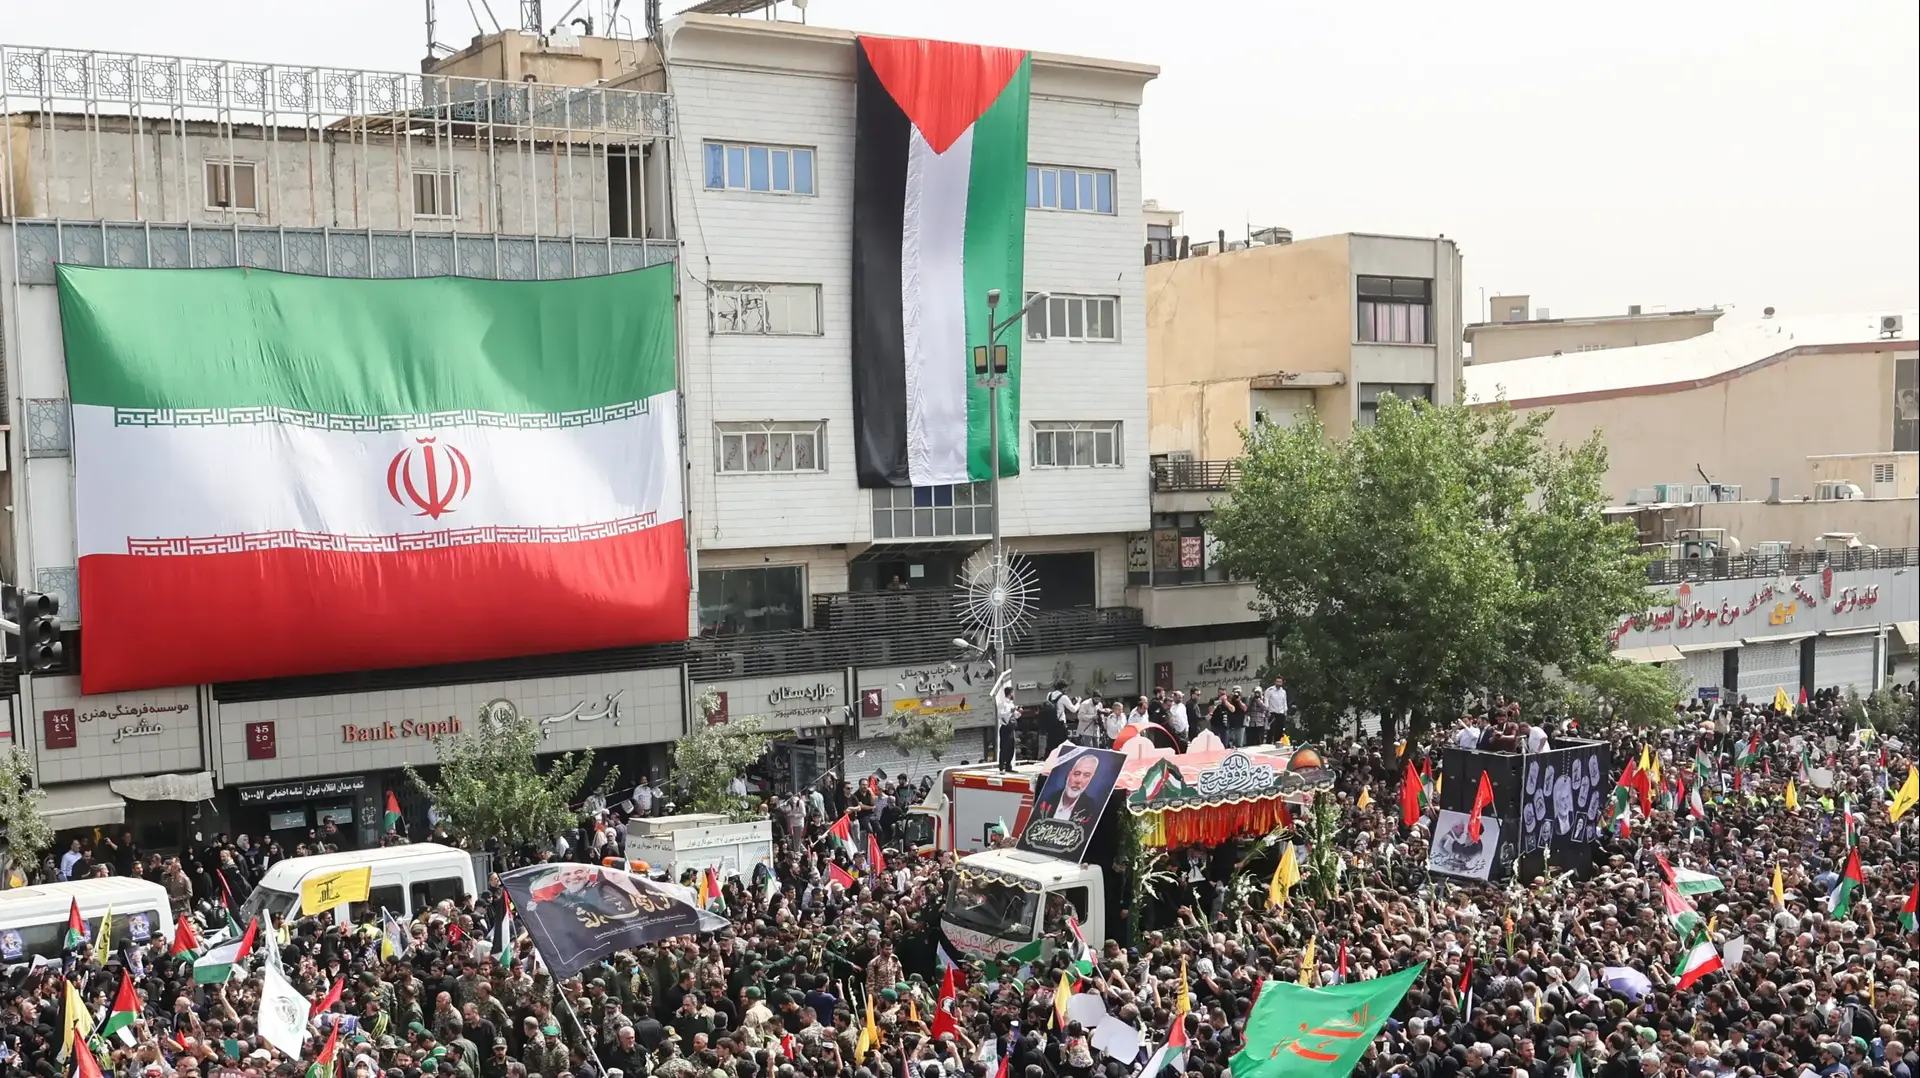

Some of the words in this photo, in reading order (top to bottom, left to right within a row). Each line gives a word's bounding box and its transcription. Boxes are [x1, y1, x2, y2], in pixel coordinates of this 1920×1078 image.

[78, 708, 108, 723] هنری
[108, 703, 148, 719] فرهنگی
[149, 703, 190, 714] موسسه
[52, 714, 68, 723] 46
[112, 718, 163, 744] مشعر
[255, 725, 269, 734] 45
[342, 722, 398, 744] Bank
[402, 716, 462, 741] Sepah
